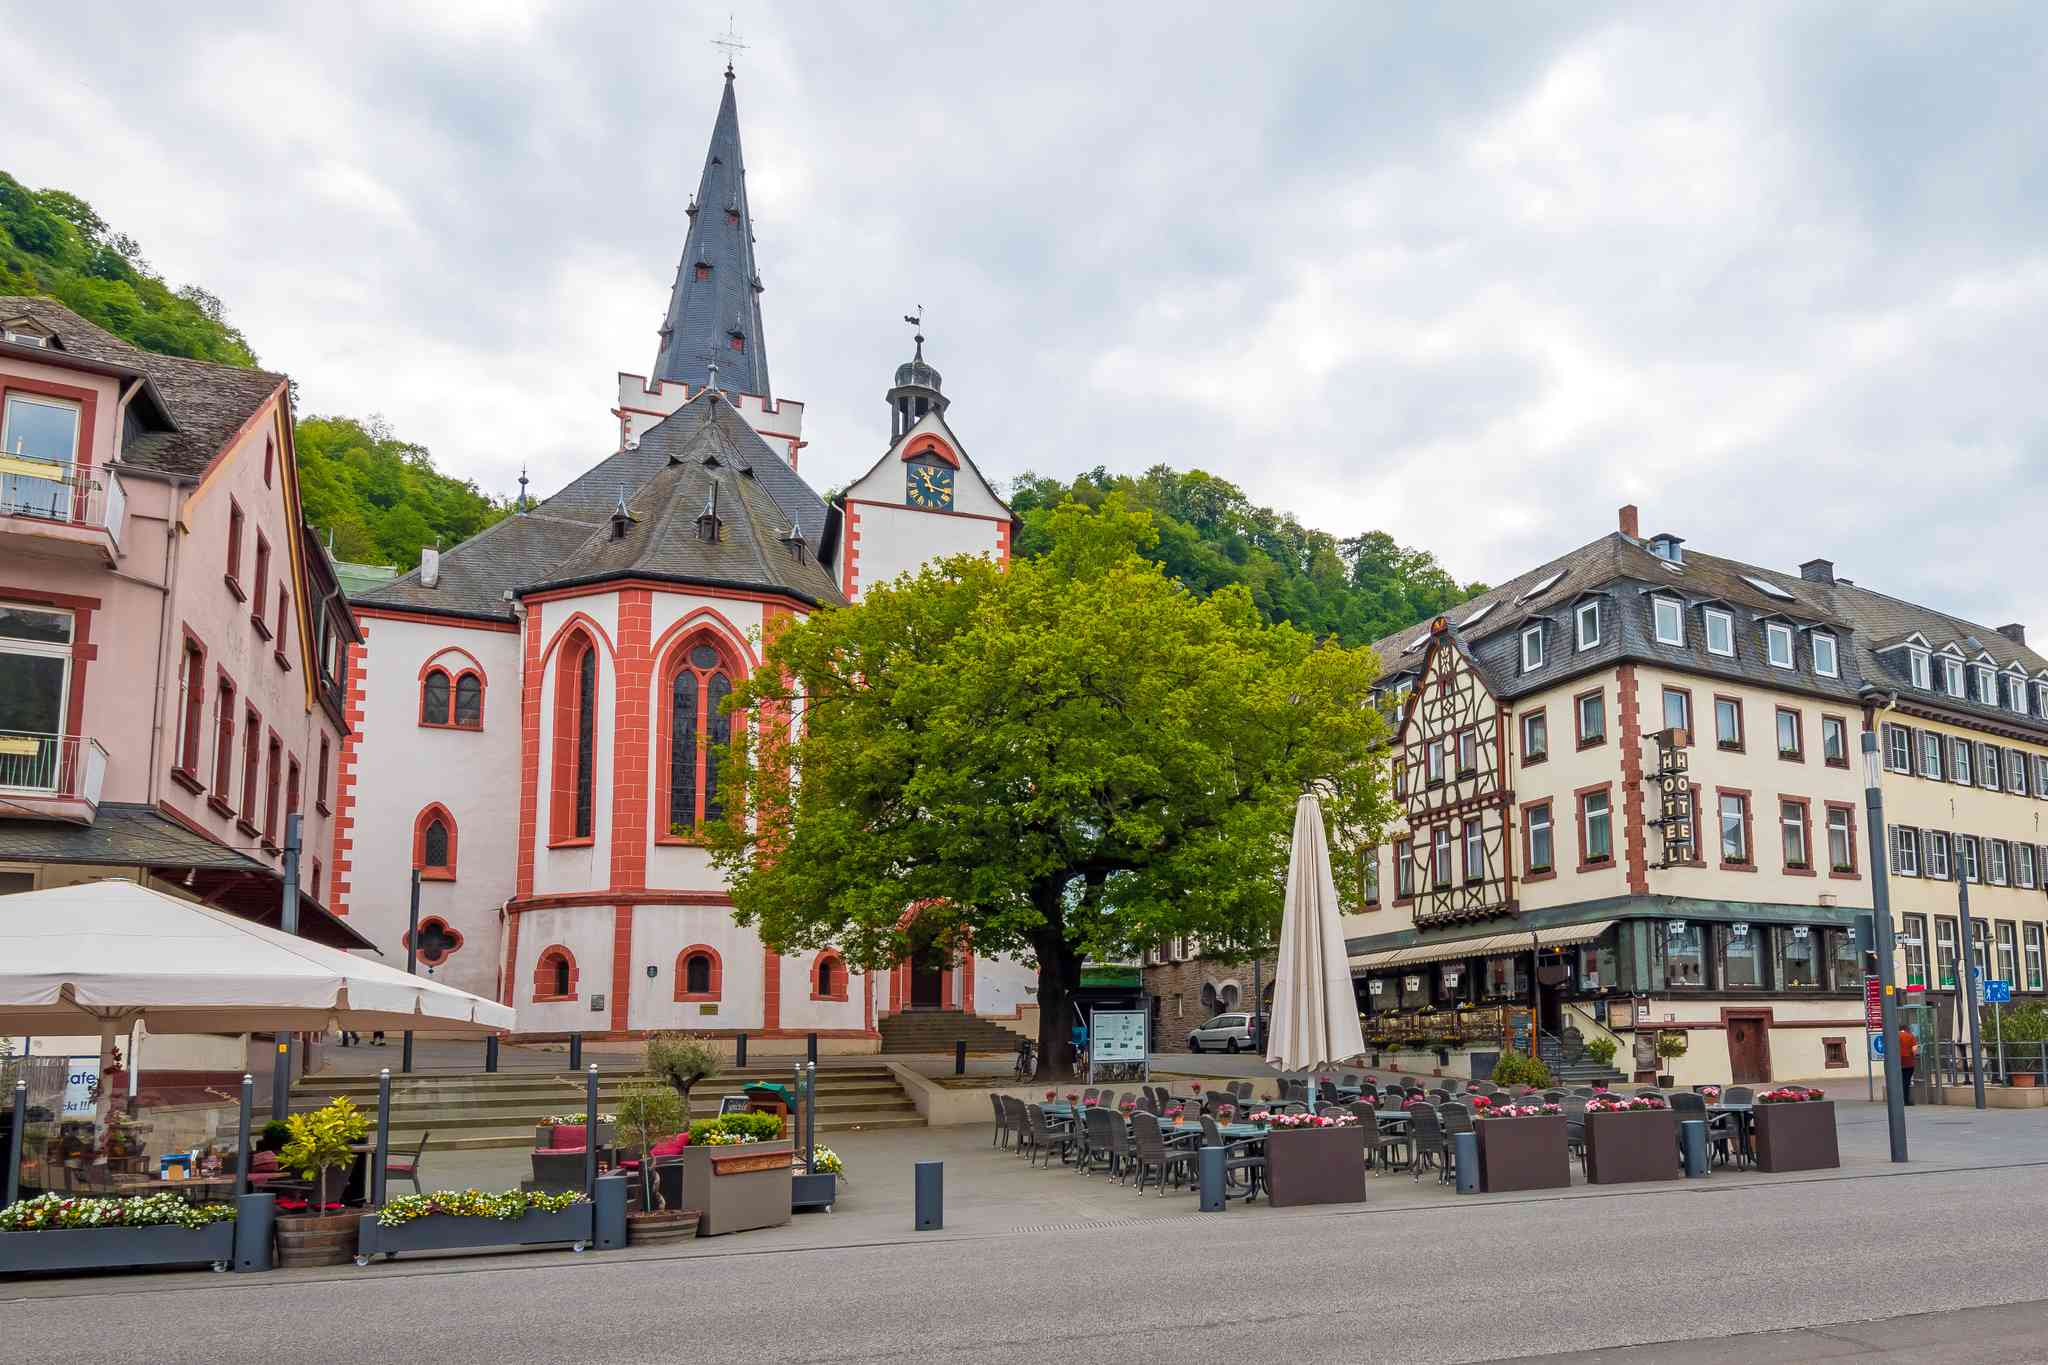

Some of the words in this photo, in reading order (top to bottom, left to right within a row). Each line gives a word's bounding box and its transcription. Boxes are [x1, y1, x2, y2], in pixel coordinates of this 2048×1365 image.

[1662, 753, 1678, 862] HOTEL
[1676, 753, 1691, 861] HOTEL
[65, 1072, 96, 1085] afe
